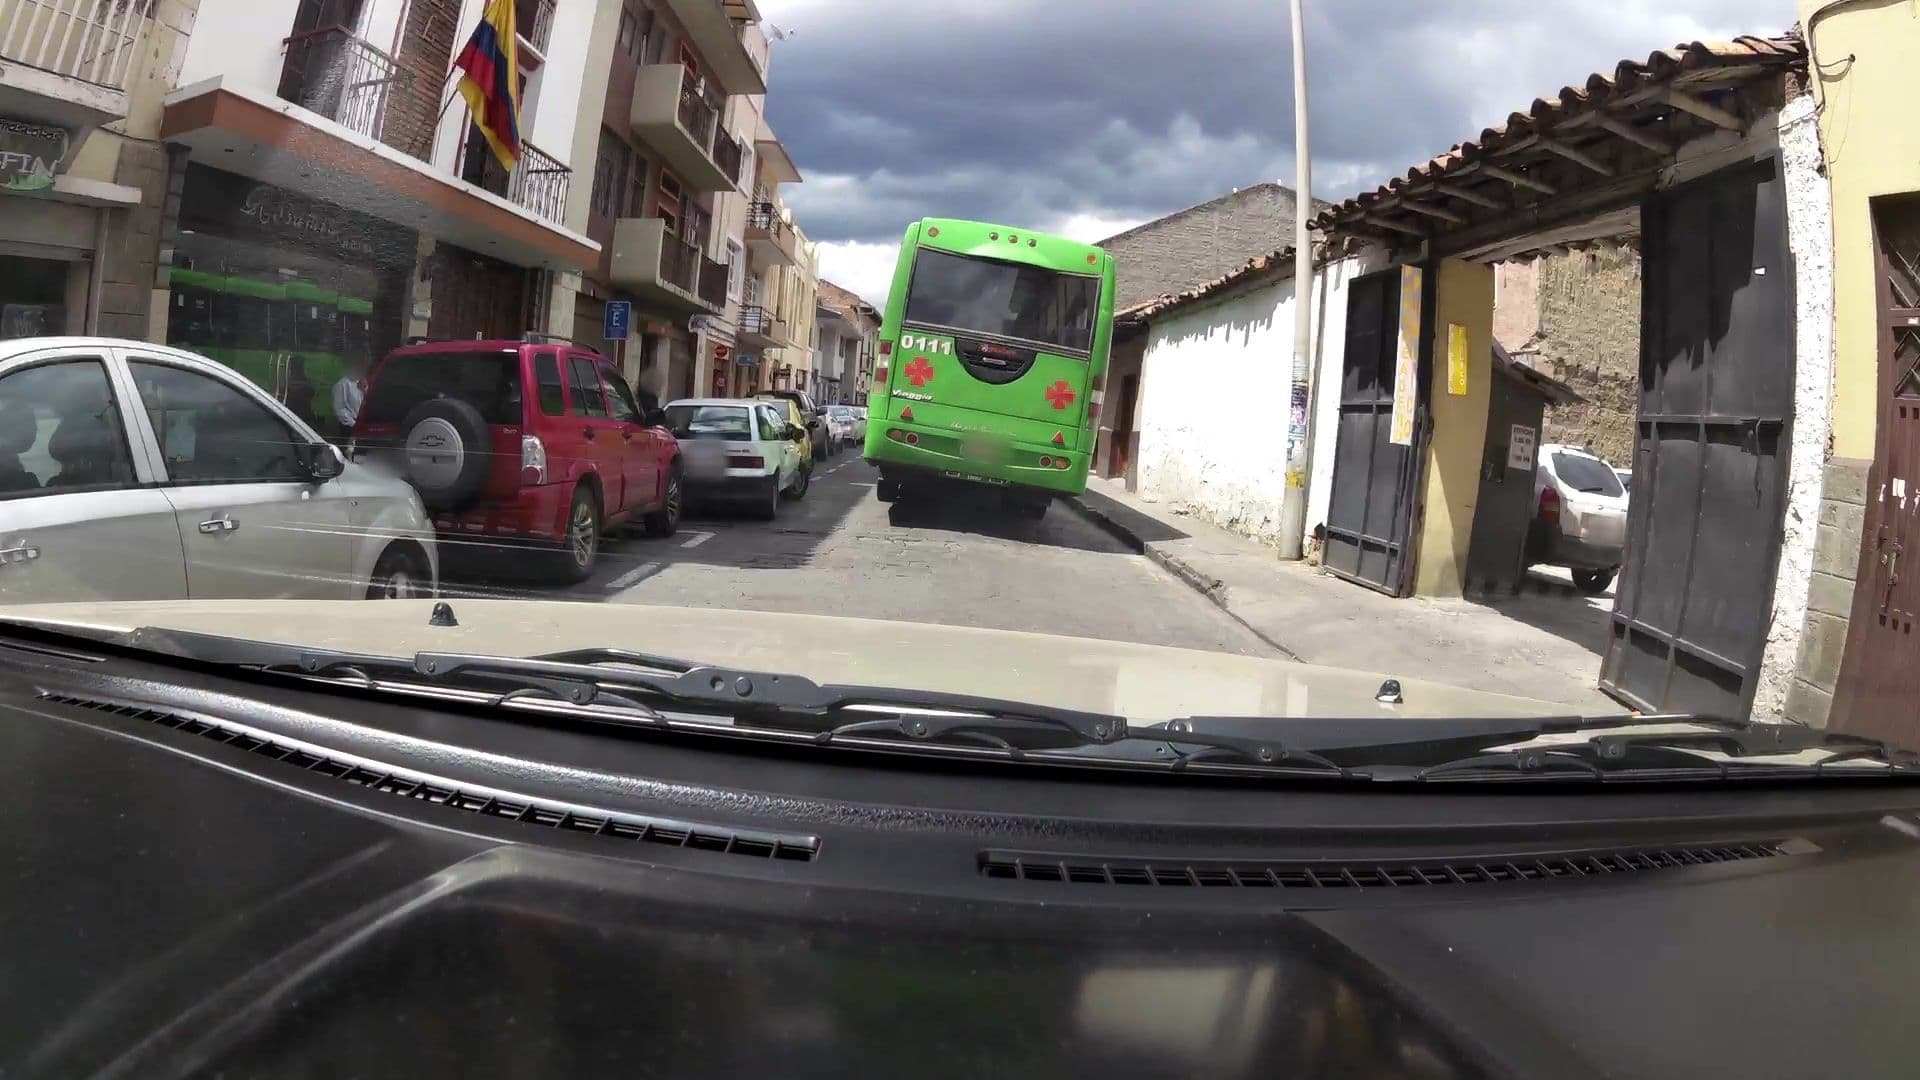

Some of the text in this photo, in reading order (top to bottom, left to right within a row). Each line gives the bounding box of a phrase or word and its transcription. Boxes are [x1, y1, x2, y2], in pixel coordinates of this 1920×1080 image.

[612, 311, 621, 326] E
[901, 335, 952, 355] 0111
[892, 389, 932, 401] Viaggio
